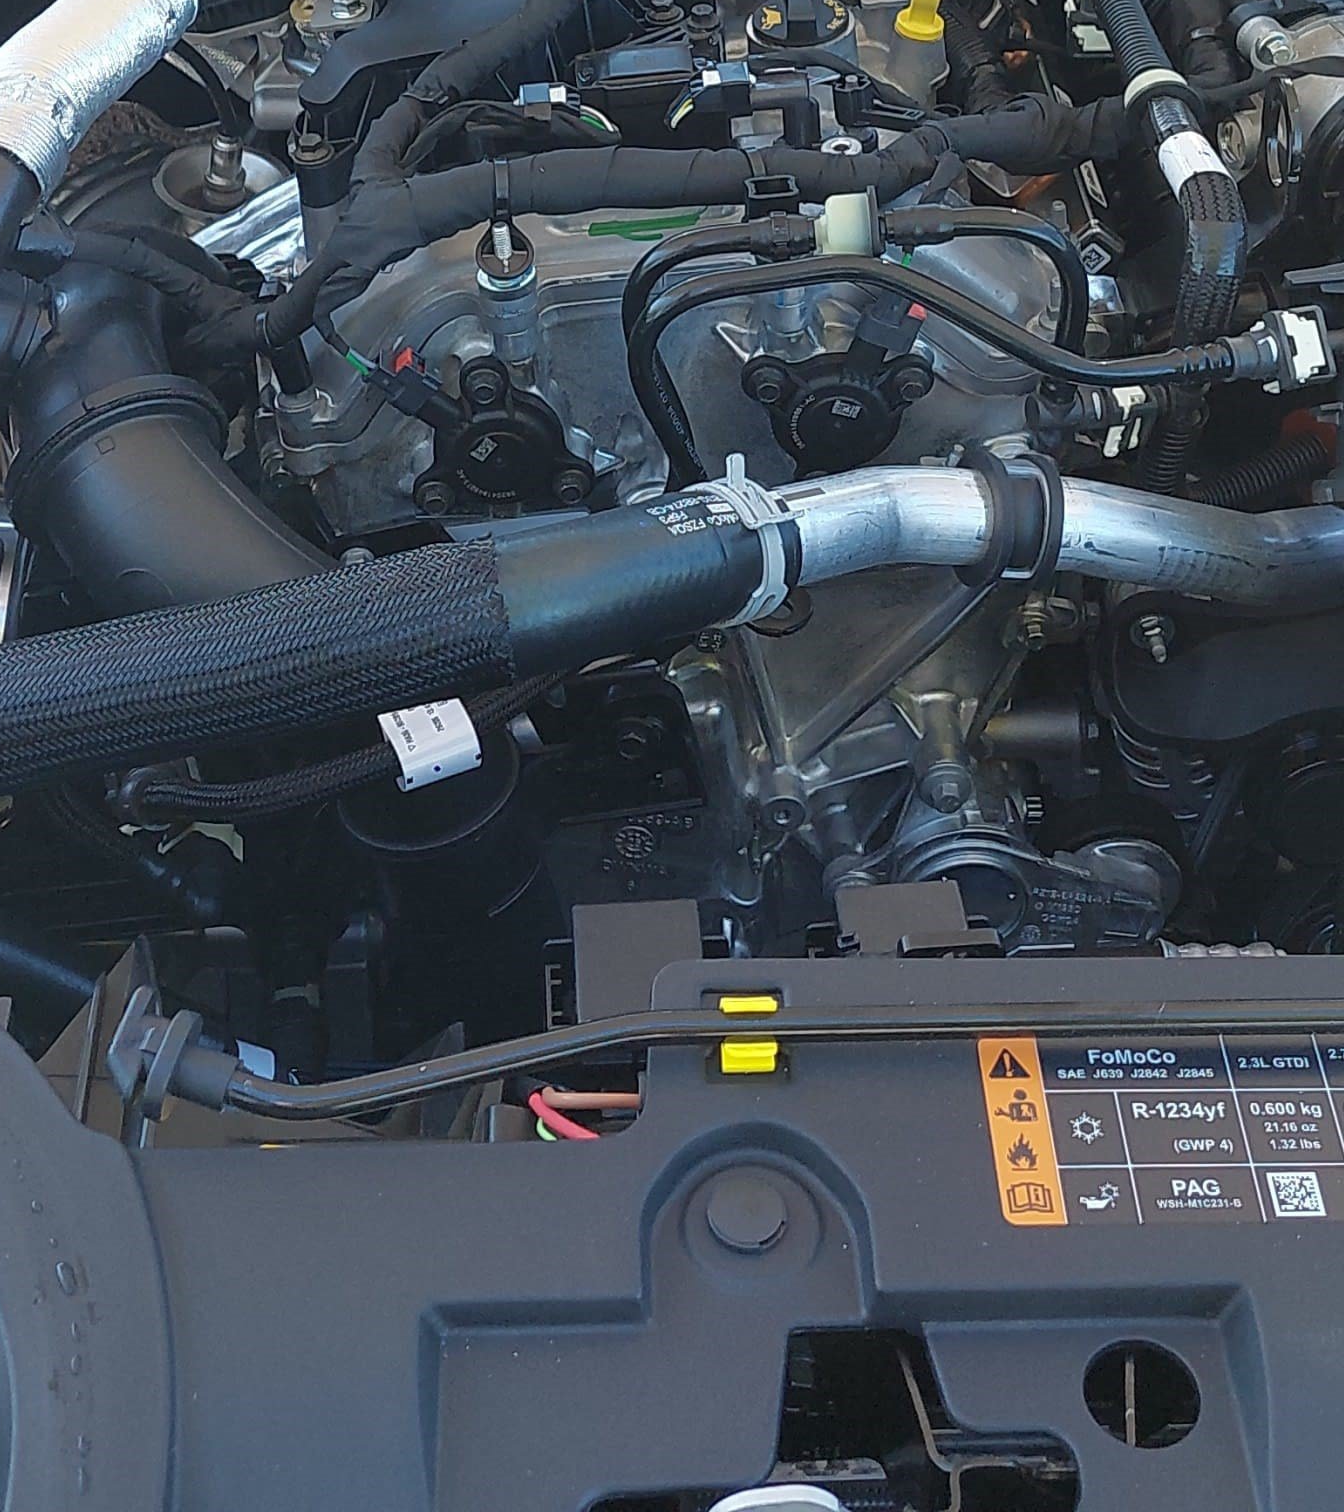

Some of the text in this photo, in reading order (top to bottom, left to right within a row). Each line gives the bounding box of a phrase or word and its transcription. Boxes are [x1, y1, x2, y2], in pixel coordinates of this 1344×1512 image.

[1087, 1049, 1176, 1065] FoMoCo
[1237, 1057, 1311, 1069] 2.3L GTDI
[1057, 1068, 1214, 1079] SAE J639 J2842 J2845
[1132, 1102, 1226, 1122] R-1234yf
[1249, 1102, 1323, 1119] 0.600 kg
[1264, 1122, 1318, 1133] 21.16 oz
[1173, 1138, 1234, 1154] (GWP 4)
[1269, 1138, 1322, 1150] 1.32 lbs
[1171, 1179, 1221, 1196] PAG
